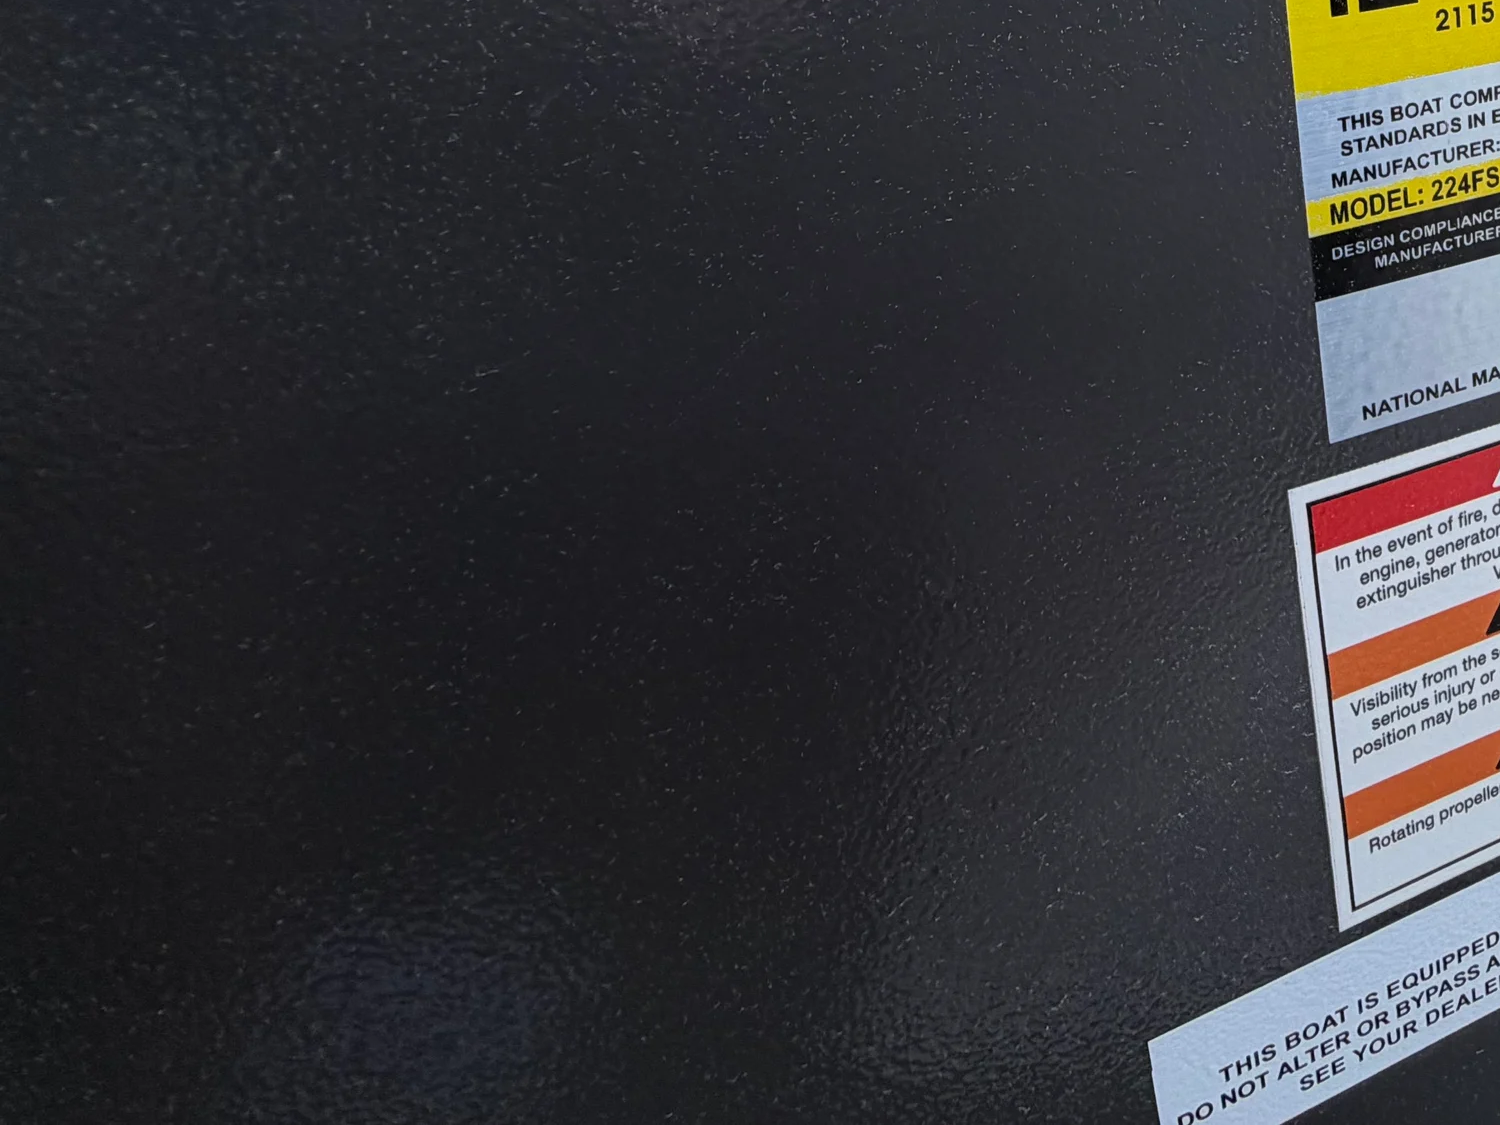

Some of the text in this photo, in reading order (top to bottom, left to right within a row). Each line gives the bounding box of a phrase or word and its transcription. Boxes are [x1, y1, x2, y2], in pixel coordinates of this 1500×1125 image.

[1435, 1, 1495, 32] 2115
[1337, 109, 1384, 132] THIS
[1390, 97, 1443, 122] BOAT
[1340, 119, 1461, 157] STANDARDS
[1468, 112, 1485, 129] IN
[1331, 138, 1500, 189] MANUFACTURER:
[1330, 166, 1500, 225] MODEL: 224FS
[1331, 234, 1395, 261] DESIGN
[1362, 378, 1466, 420] NATIONAL
[1335, 555, 1350, 572] In
[1355, 546, 1382, 565] the
[1387, 526, 1433, 554] event
[1437, 519, 1454, 534] of
[1458, 510, 1487, 530] fire,
[1360, 558, 1419, 586] engine,
[1350, 680, 1417, 717] Visibility
[1421, 665, 1458, 689] from
[1462, 653, 1487, 671] the
[1368, 814, 1435, 854] Rotating
[1218, 1044, 1277, 1083] THIS
[1284, 1005, 1349, 1051] BOAT
[1357, 992, 1379, 1014] IS
[1386, 931, 1500, 1000] EQUIPPED
[1177, 1102, 1213, 1125] DO
[1220, 1071, 1269, 1110] NOT
[1277, 1030, 1352, 1080] ALTER
[1357, 1010, 1390, 1036] OR
[1396, 964, 1480, 1019] BYPASS
[1299, 1056, 1346, 1092] SEE
[1352, 1019, 1418, 1062] YOUR
